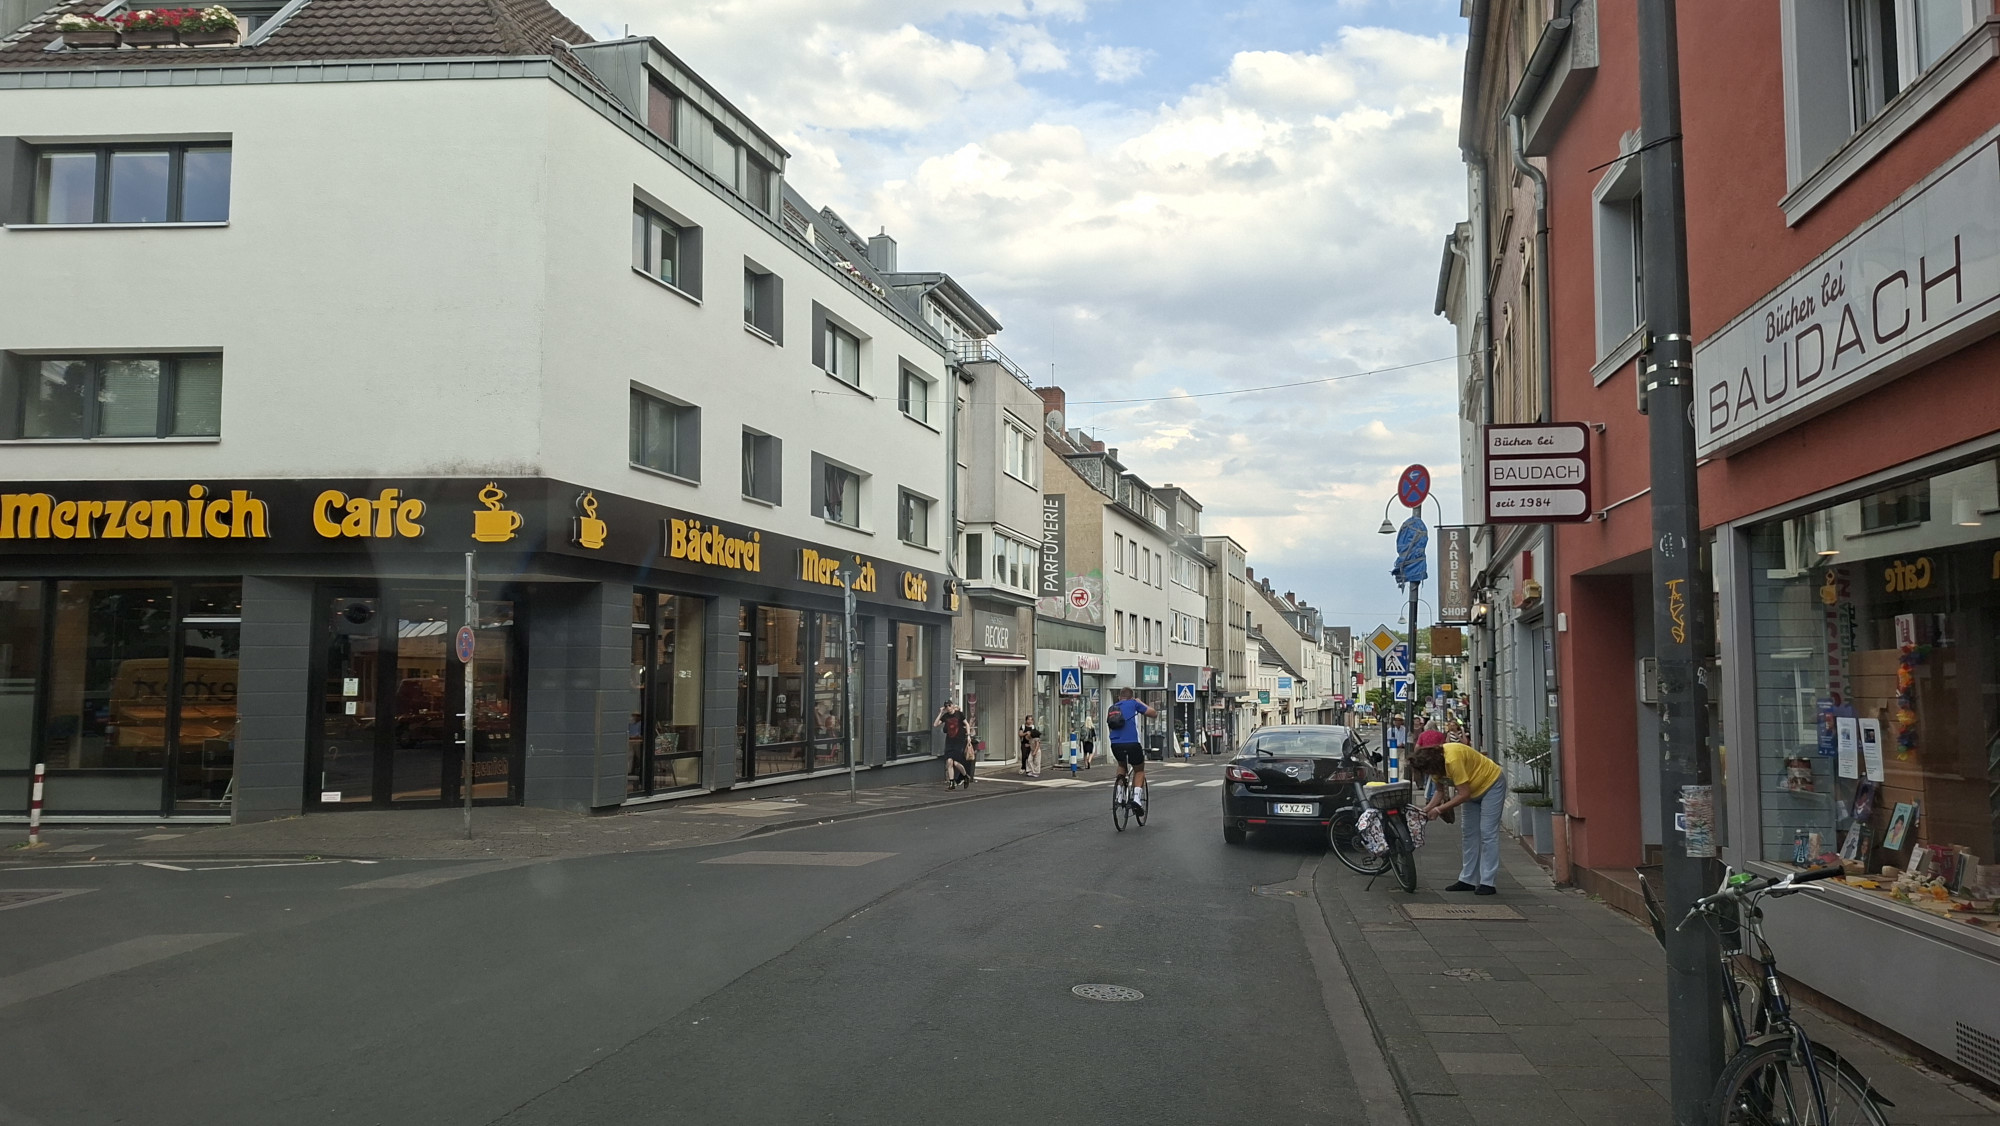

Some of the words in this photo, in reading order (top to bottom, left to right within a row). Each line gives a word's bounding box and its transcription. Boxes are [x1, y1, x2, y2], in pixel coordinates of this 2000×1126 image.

[1765, 296, 1815, 343] Bücher
[1821, 260, 1845, 307] bei
[1709, 234, 1962, 434] BAUDACH
[1494, 437, 1532, 446] Bücher
[1537, 435, 1554, 445] bei
[1494, 465, 1579, 480] BAUDACH
[0, 484, 267, 539] Merzenich
[313, 488, 424, 538] Cafe
[1495, 498, 1515, 508] seit
[1519, 498, 1551, 507] 1984
[670, 518, 760, 572] Bäckerei
[1043, 499, 1059, 592] PARFÜMERIE
[1449, 531, 1459, 590] BARBER
[904, 571, 928, 602] Cafe
[1441, 607, 1467, 616] SHOP
[985, 624, 1009, 649] BECKER
[1279, 804, 1285, 813] K
[1289, 804, 1300, 813] XZ
[1301, 805, 1311, 813] 75
